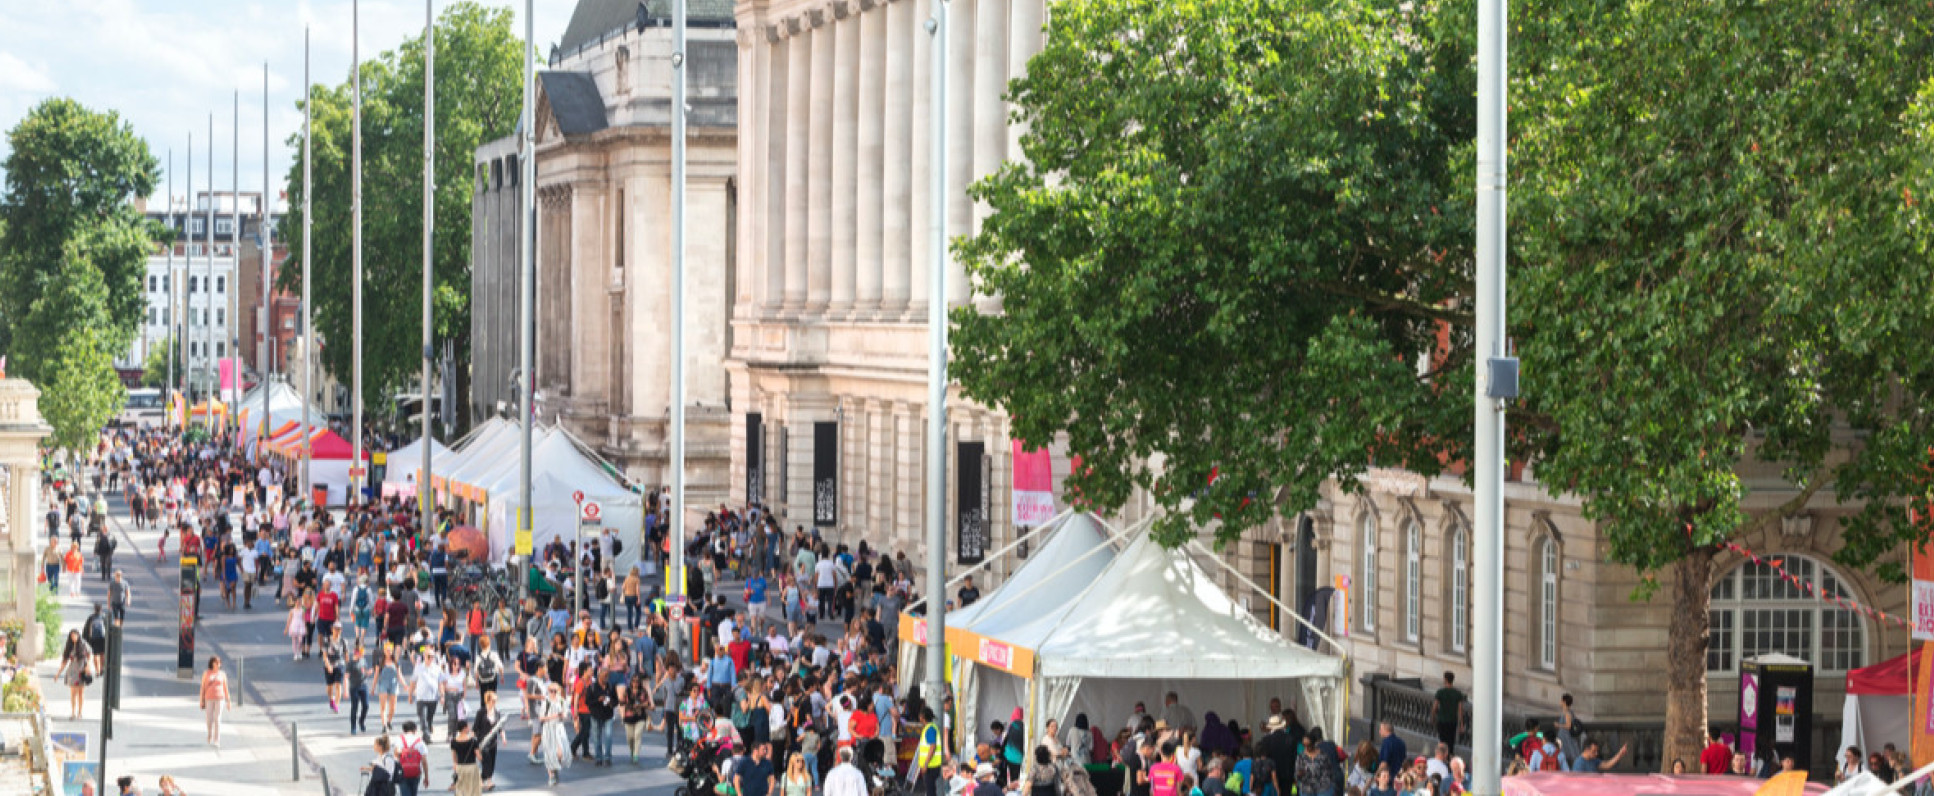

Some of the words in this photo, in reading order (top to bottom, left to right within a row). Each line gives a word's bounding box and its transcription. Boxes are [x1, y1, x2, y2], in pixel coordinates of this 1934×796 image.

[816, 480, 825, 520] SCIENCE
[826, 477, 834, 520] MUSEUM
[961, 511, 971, 557] SCIENCE
[972, 508, 981, 557] MUSEUM
